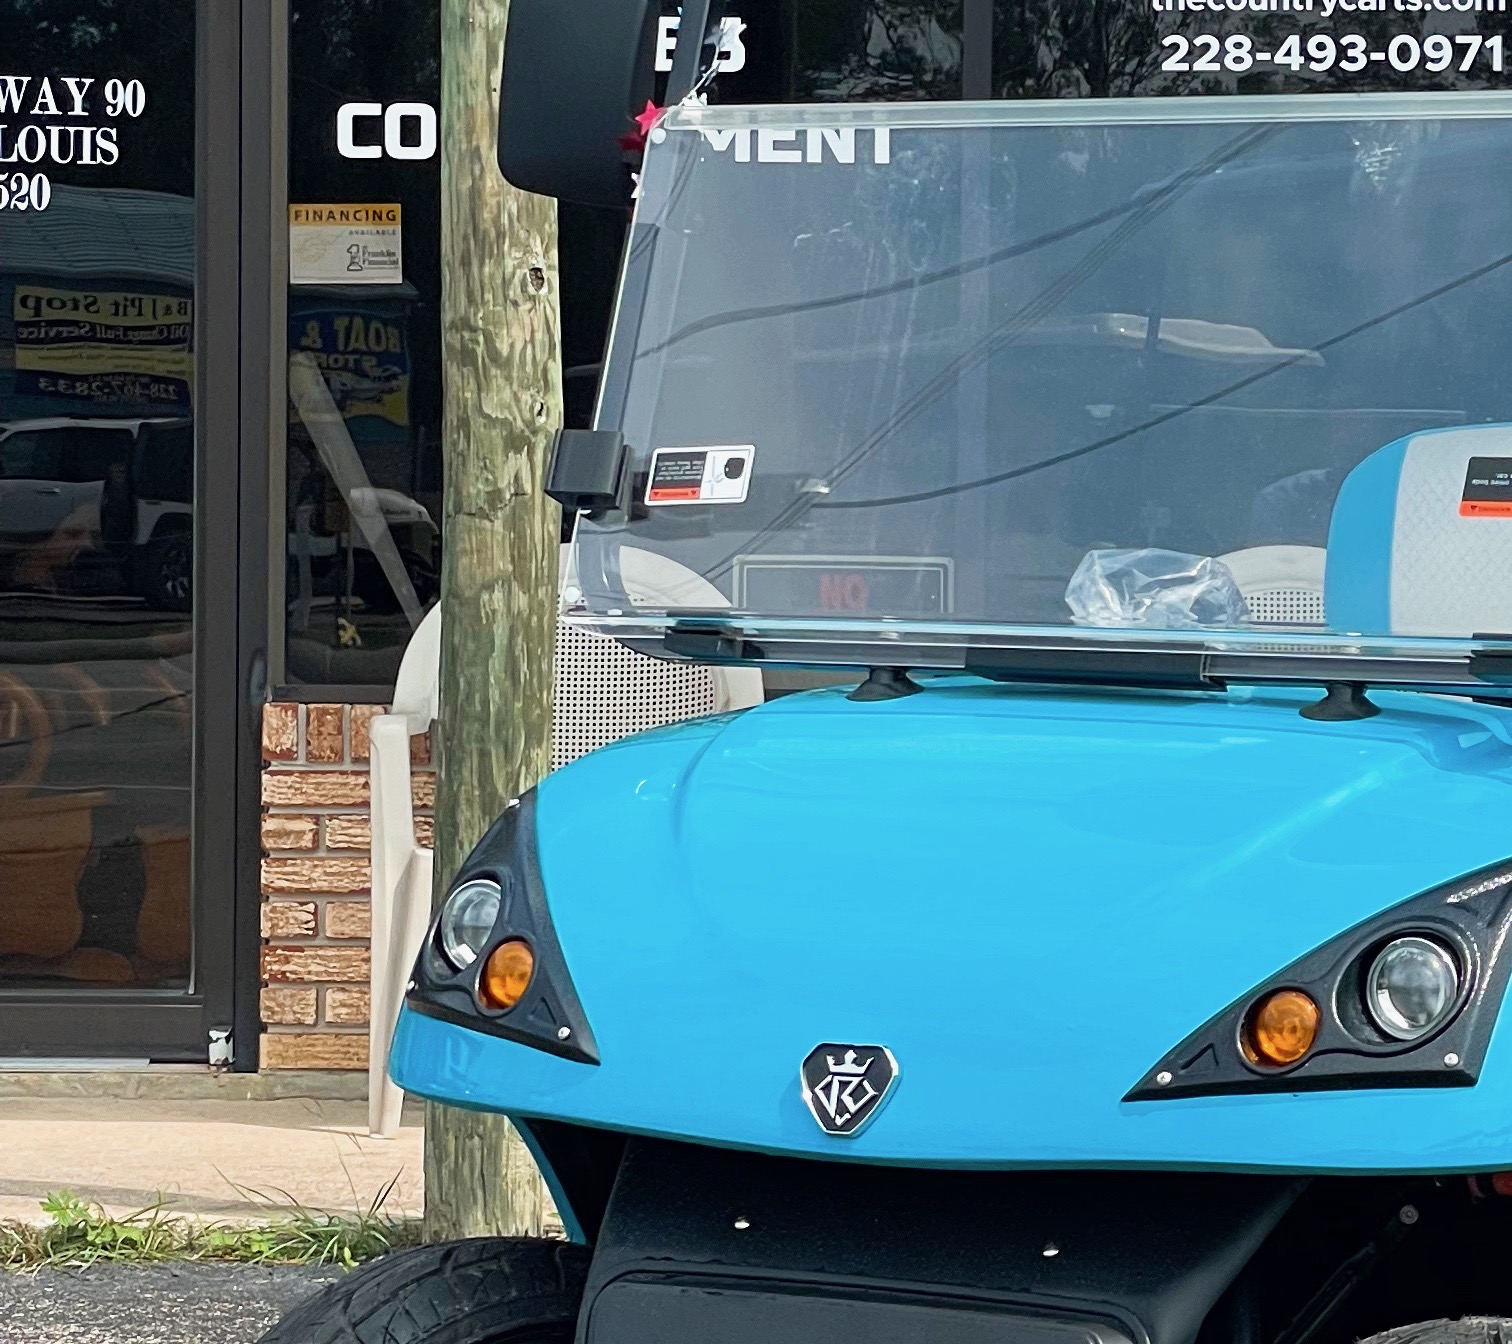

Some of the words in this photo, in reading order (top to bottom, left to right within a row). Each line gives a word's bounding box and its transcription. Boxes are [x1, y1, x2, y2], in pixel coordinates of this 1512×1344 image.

[1160, 34, 1504, 73] 228-493-0971
[0, 76, 95, 116] WAY
[104, 78, 146, 118] 90
[0, 172, 52, 212] 520
[294, 209, 397, 222] FINANCING
[349, 228, 397, 236] AVAILABLE
